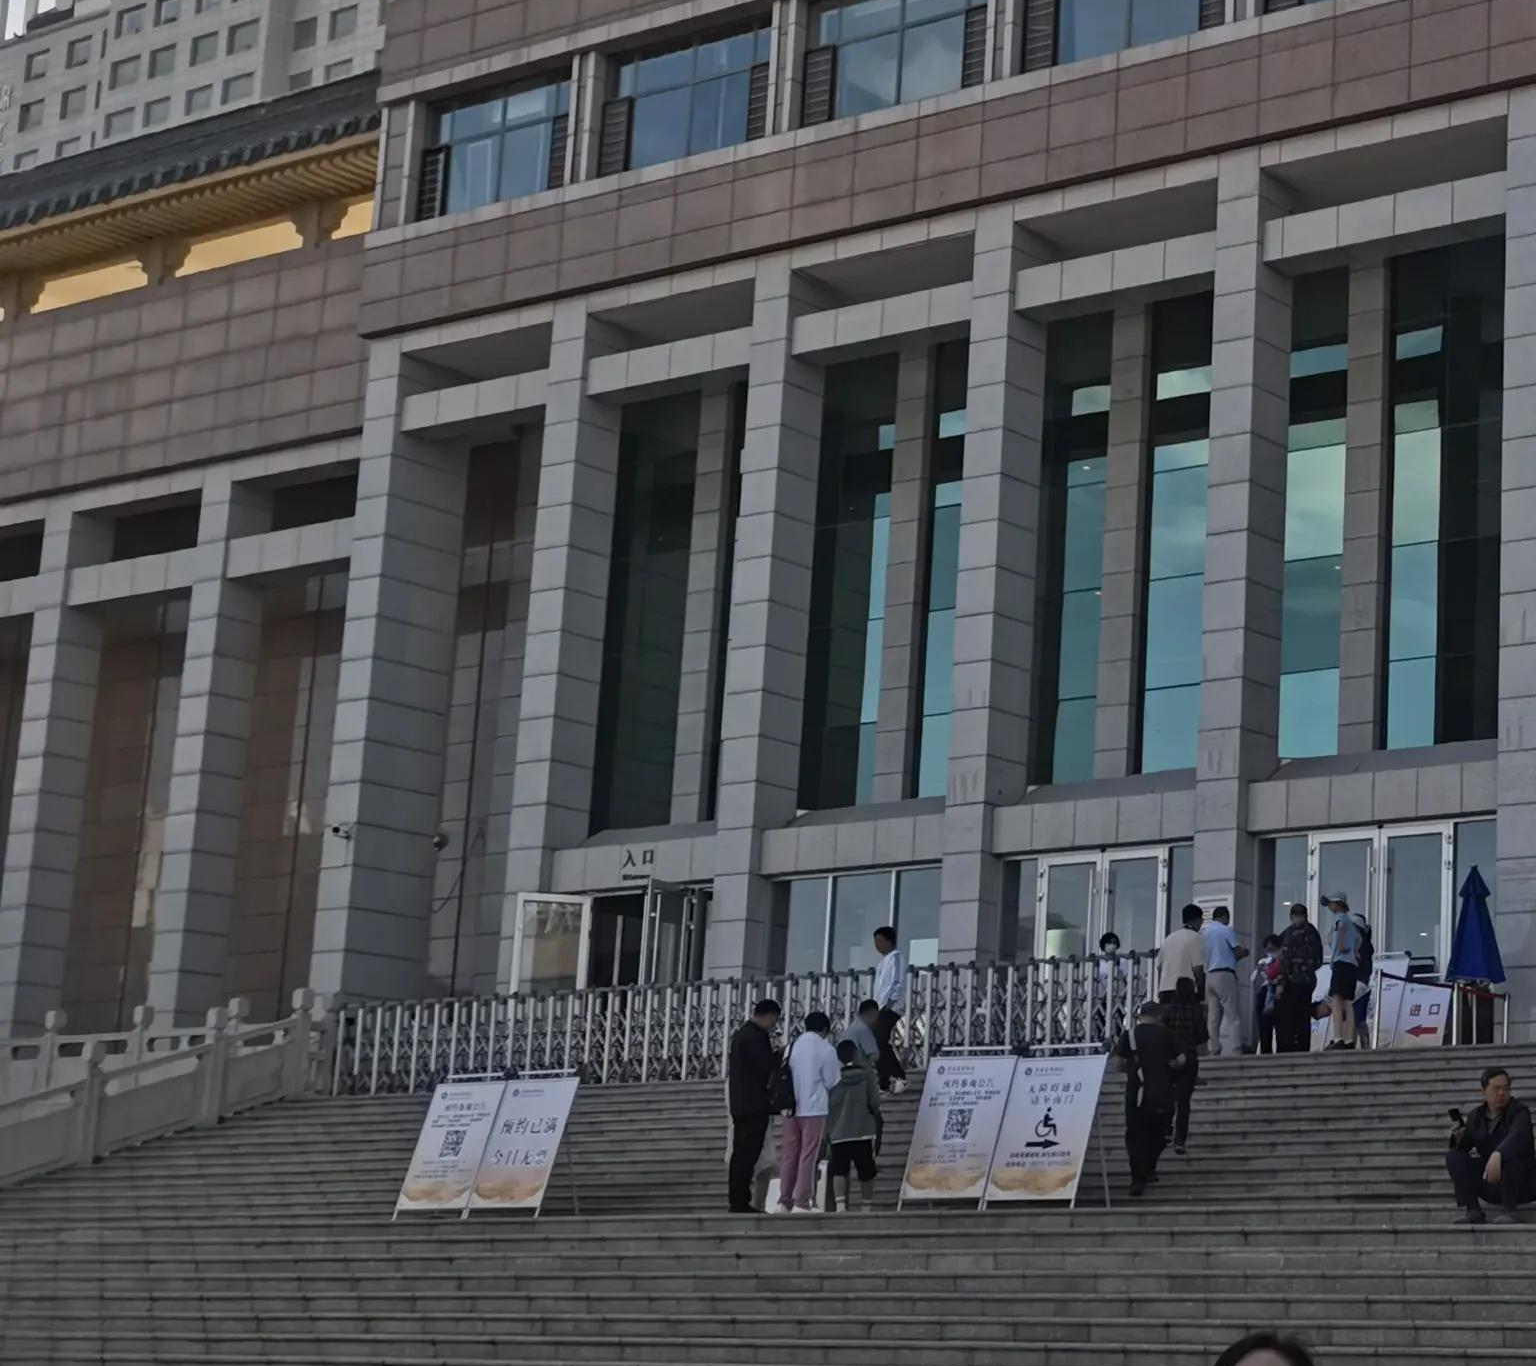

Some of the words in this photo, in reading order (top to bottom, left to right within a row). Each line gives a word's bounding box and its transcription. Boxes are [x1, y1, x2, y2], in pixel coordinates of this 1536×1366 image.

[621, 849, 655, 869] 入口
[499, 1117, 560, 1136] 预约已满
[494, 1149, 548, 1165] 今日无票
